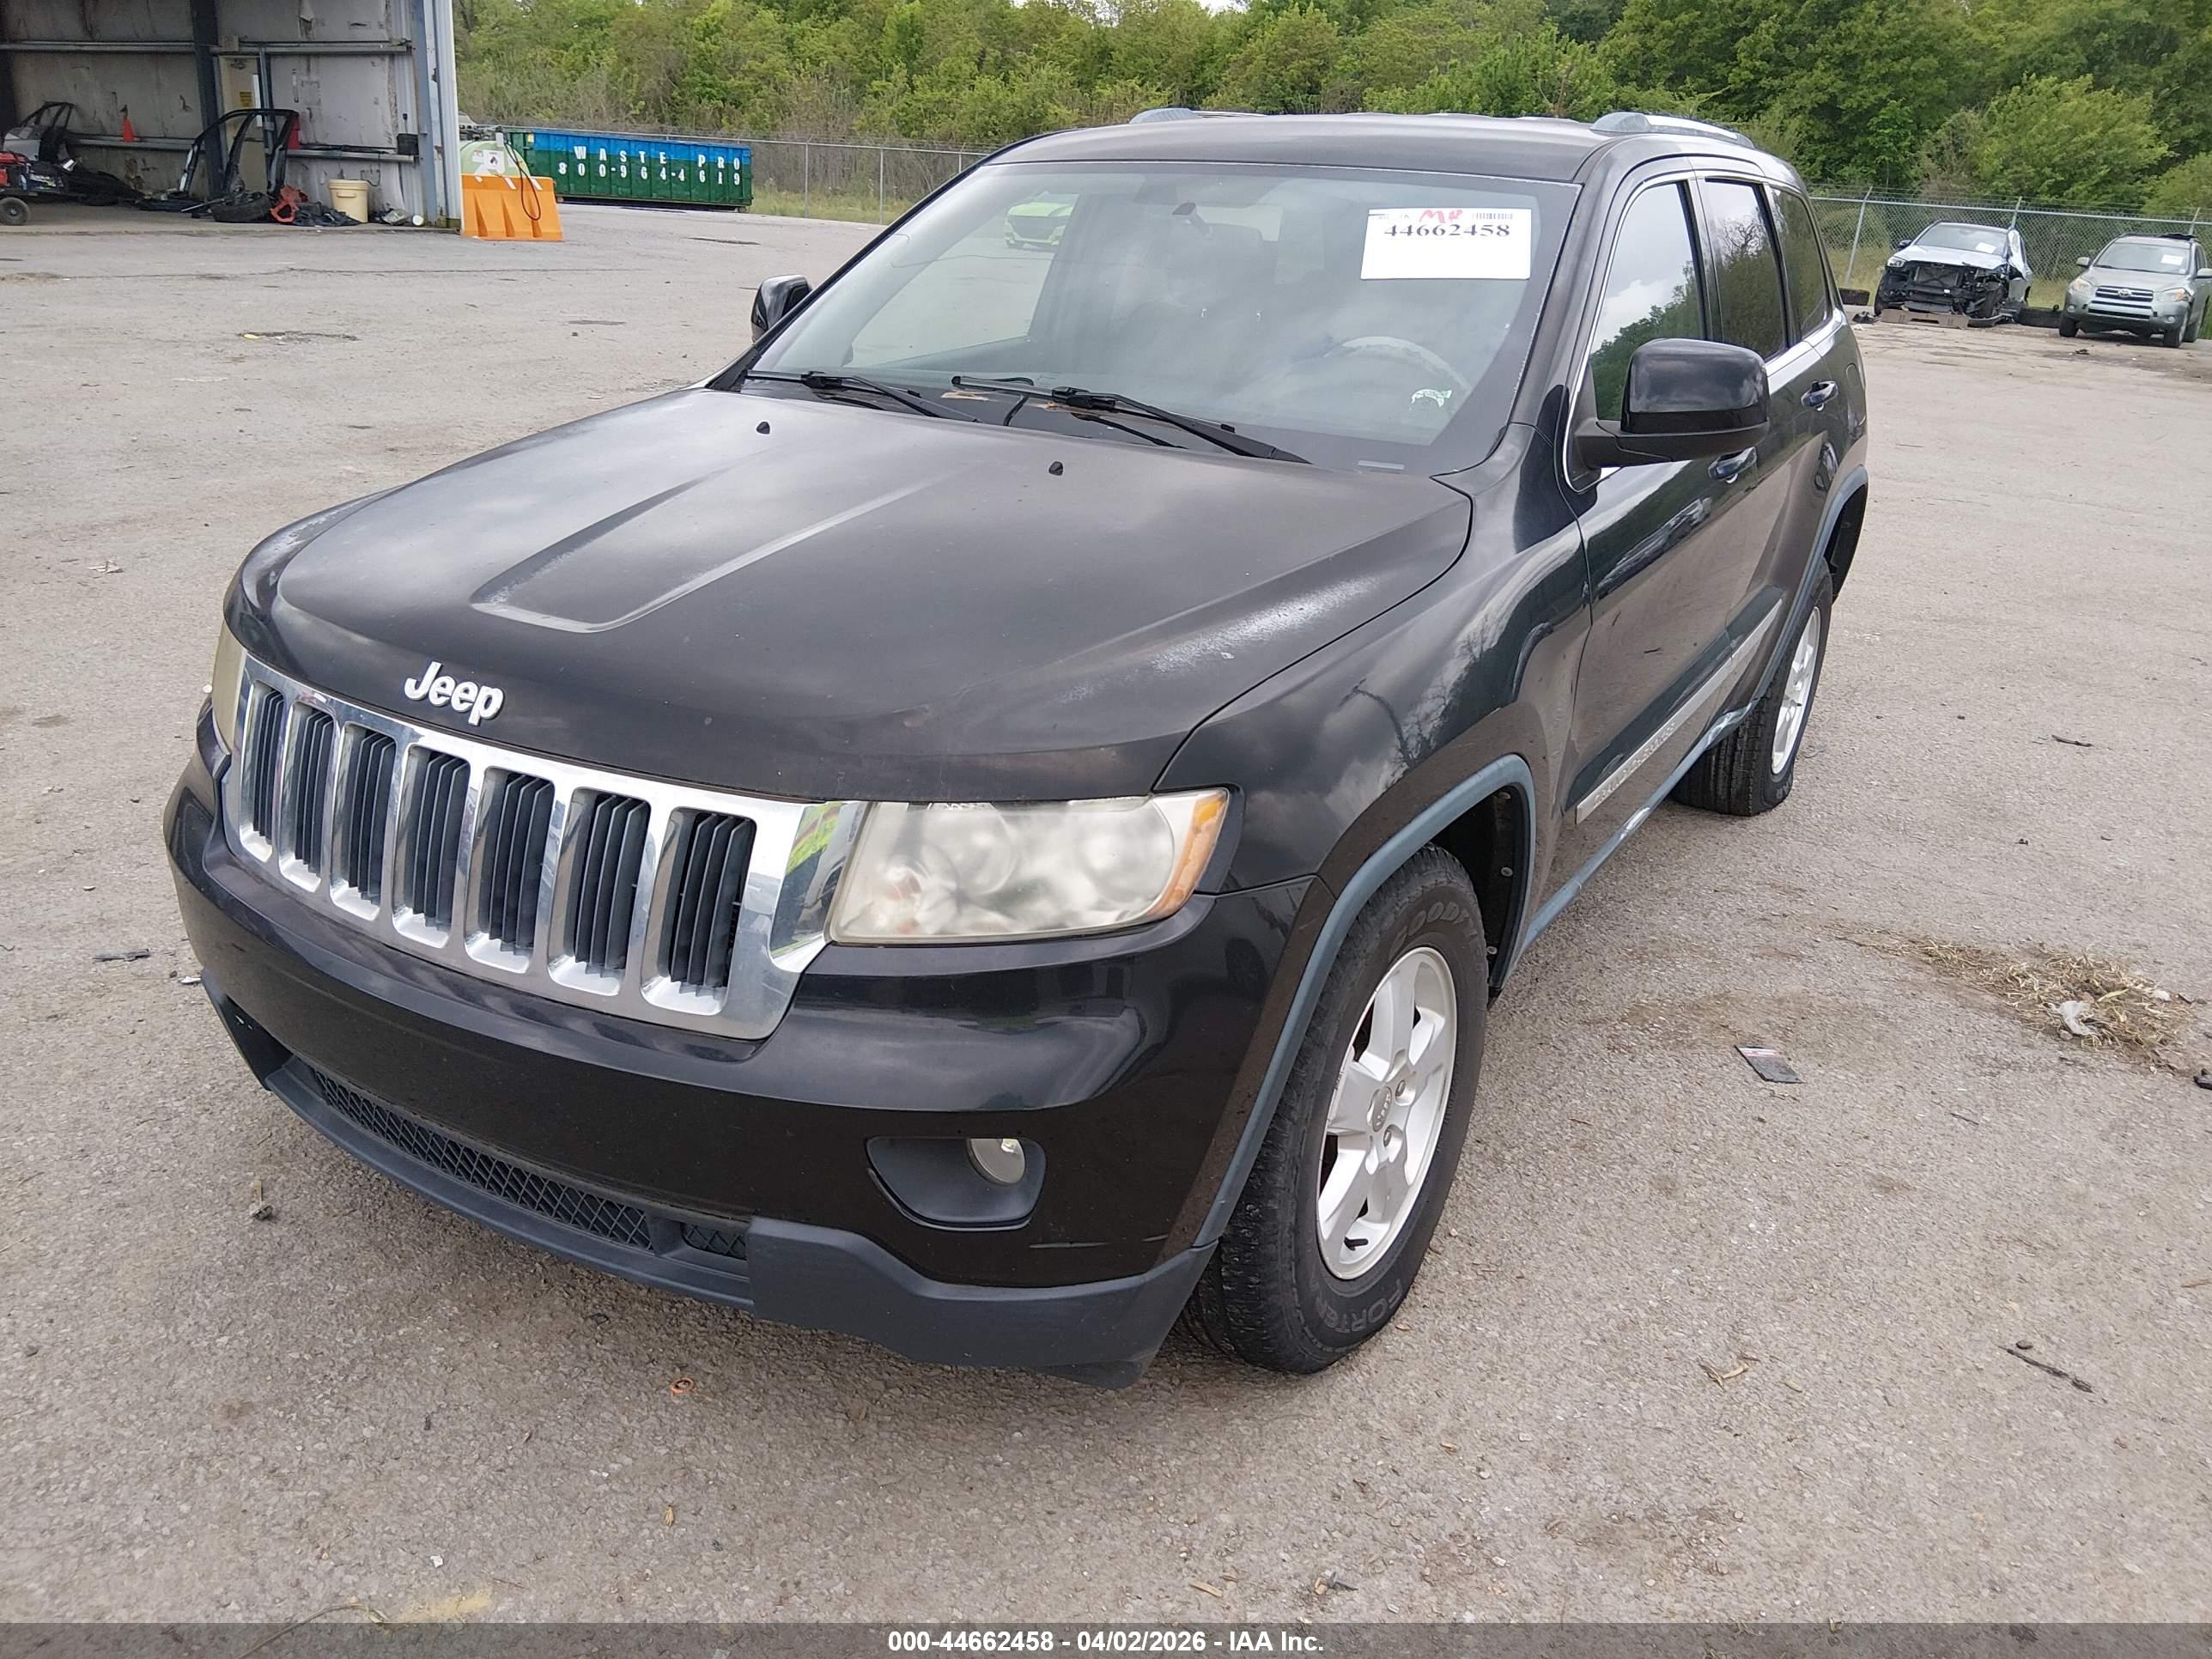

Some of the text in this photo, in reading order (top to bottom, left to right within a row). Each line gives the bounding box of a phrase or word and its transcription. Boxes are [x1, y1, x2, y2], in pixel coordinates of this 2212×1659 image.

[574, 146, 740, 171] WASTE PRO
[558, 161, 740, 185] 800-964-4619
[1384, 224, 1510, 237] 44662458
[404, 661, 504, 726] Jeep
